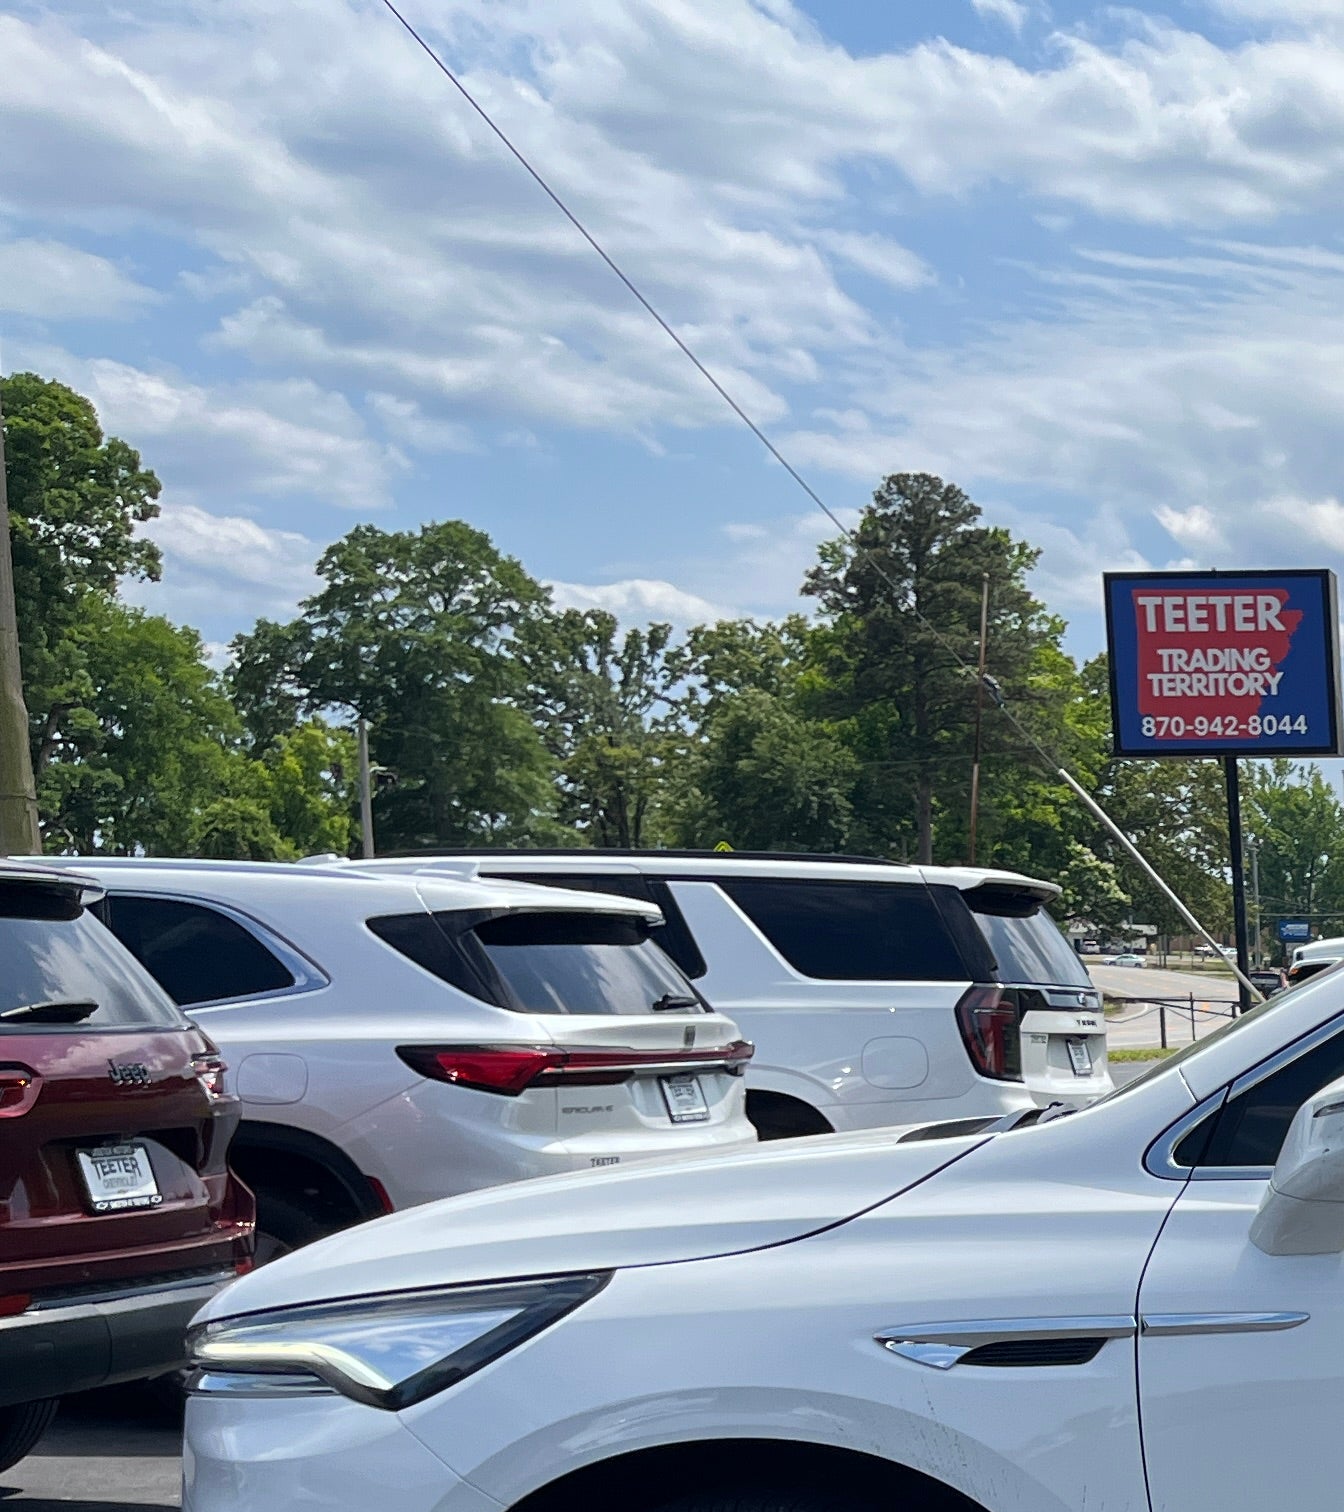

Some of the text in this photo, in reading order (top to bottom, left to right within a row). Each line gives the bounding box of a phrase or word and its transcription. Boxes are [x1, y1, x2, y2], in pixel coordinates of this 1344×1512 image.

[1137, 595, 1286, 632] TEETER
[1157, 647, 1271, 673] TRADING
[1147, 671, 1284, 697] TERRITORY
[1141, 714, 1308, 737] 870-942-8044
[107, 1058, 152, 1088] Jeep
[90, 1156, 142, 1180] TEETER
